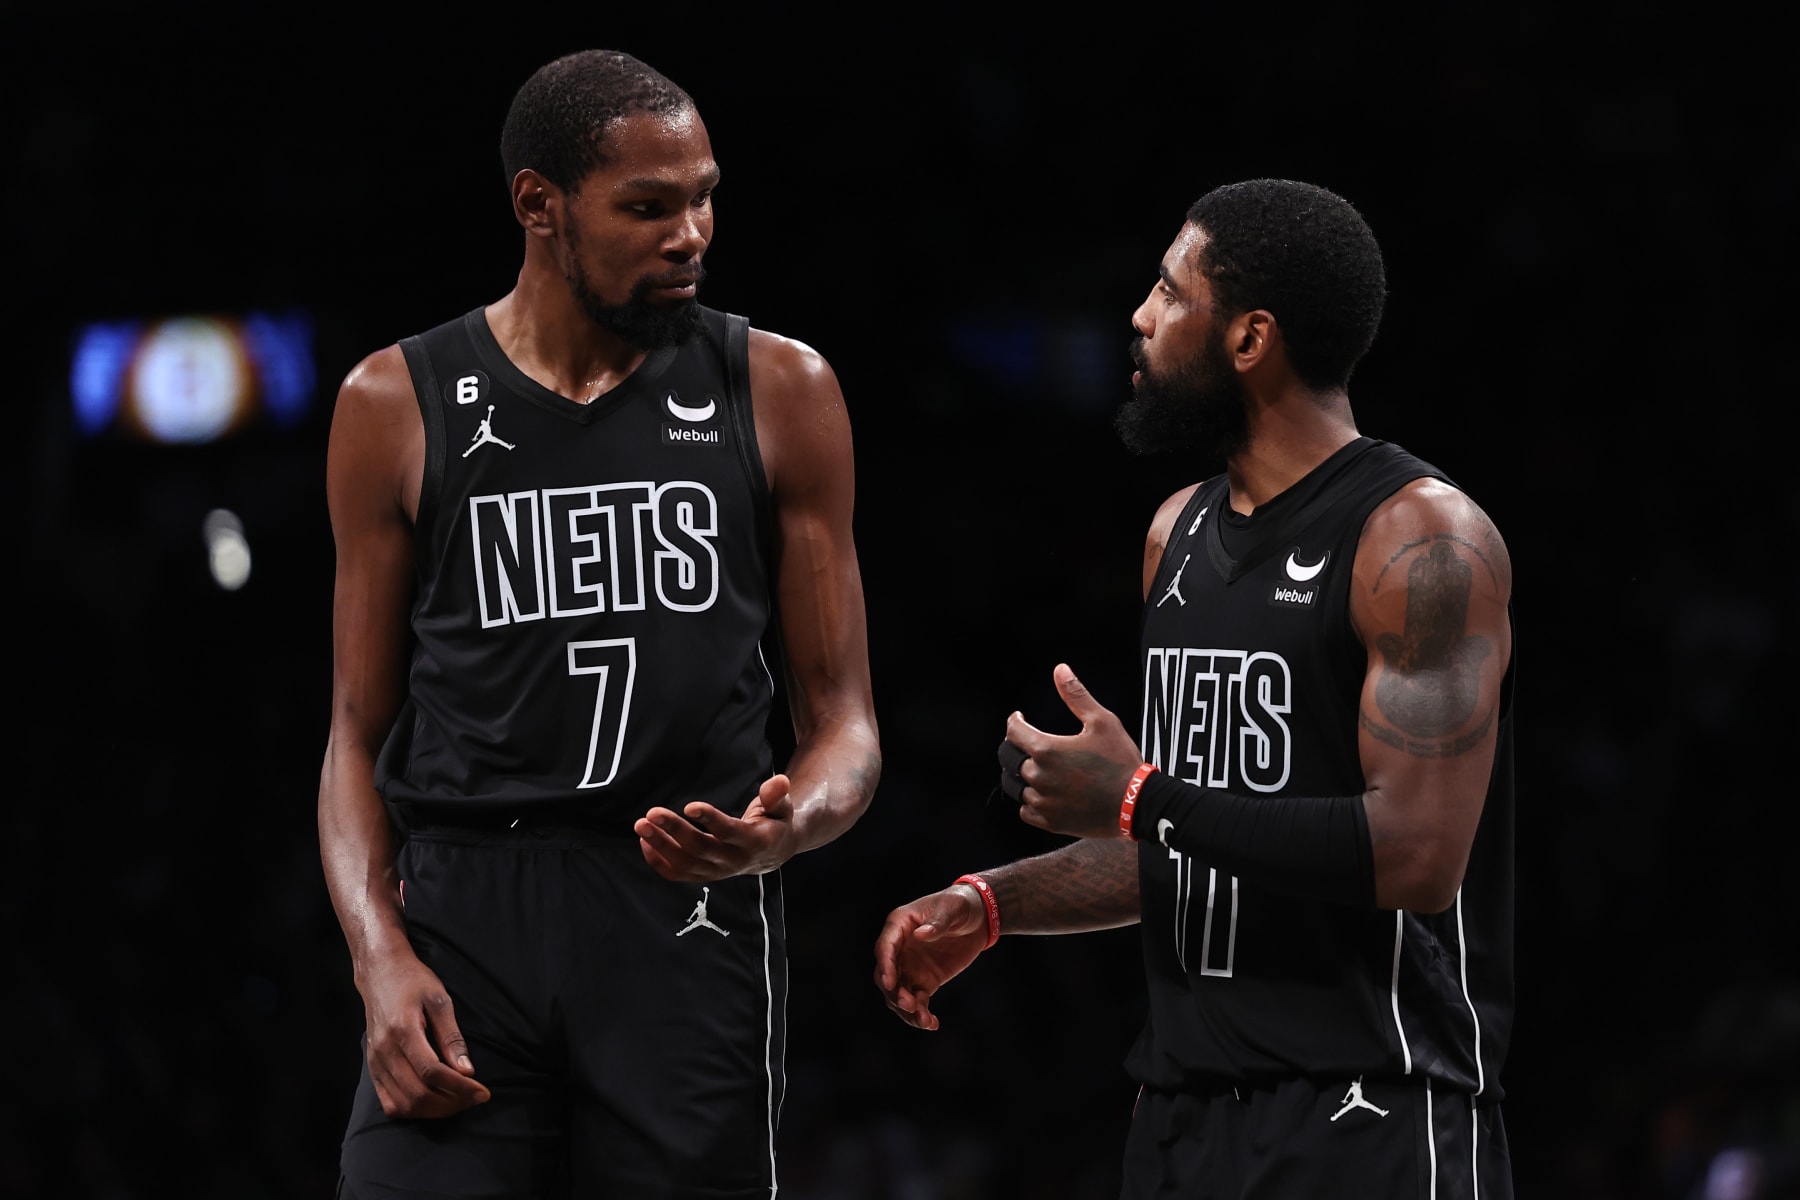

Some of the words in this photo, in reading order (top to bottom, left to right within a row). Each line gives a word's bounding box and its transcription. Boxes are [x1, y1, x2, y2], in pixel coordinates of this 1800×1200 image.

[456, 375, 479, 405] 6
[667, 427, 719, 443] Webull
[1187, 506, 1208, 536] 6
[469, 480, 720, 630] NETS
[1274, 587, 1314, 605] Webull
[567, 637, 637, 789] 7
[1142, 648, 1293, 793] NETS
